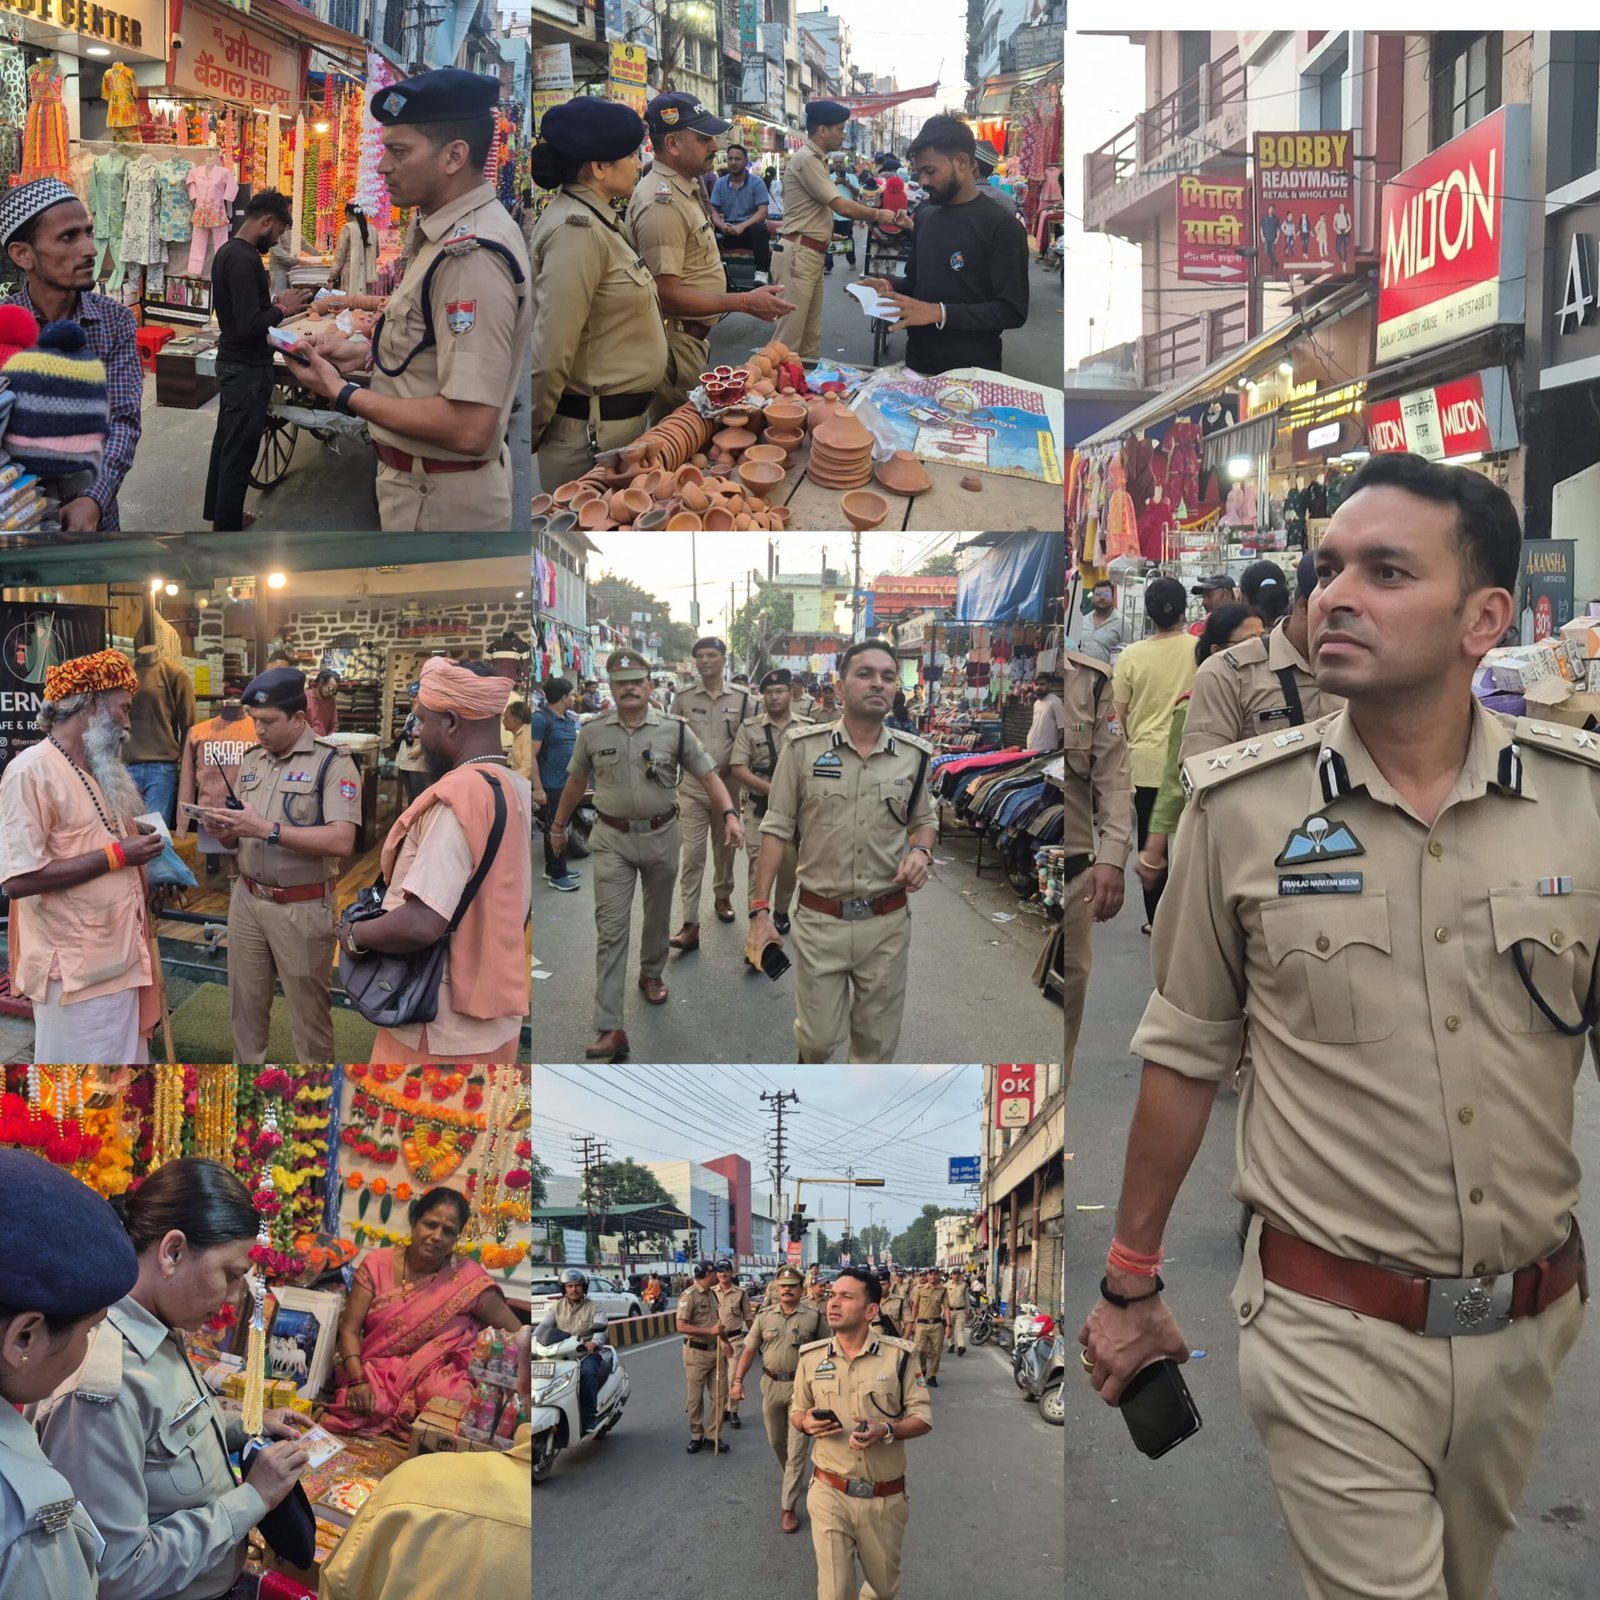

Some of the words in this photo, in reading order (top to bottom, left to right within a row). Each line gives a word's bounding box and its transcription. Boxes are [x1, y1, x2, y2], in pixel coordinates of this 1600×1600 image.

[57, 0, 142, 47] CENTER
[225, 29, 272, 78] मौसा
[194, 49, 248, 99] बैंगल
[250, 79, 291, 110] हाउस
[1259, 135, 1348, 169] BOBBY
[1180, 176, 1245, 211] मित्तल
[1262, 170, 1349, 189] READYMADE
[1263, 190, 1289, 200] RETAIL
[1299, 190, 1328, 200] WHOLE
[1329, 190, 1348, 199] SALE
[1383, 147, 1496, 290] MILTON
[1421, 314, 1438, 334] HOUSE
[1441, 397, 1488, 438] MILTON
[1368, 418, 1405, 452] MILTON
[1527, 548, 1567, 575] AKANSHA
[1536, 611, 1551, 635] 30%
[16, 720, 24, 730] &
[1338, 878, 1360, 886] MEENA
[1001, 1077, 1031, 1094] OK
